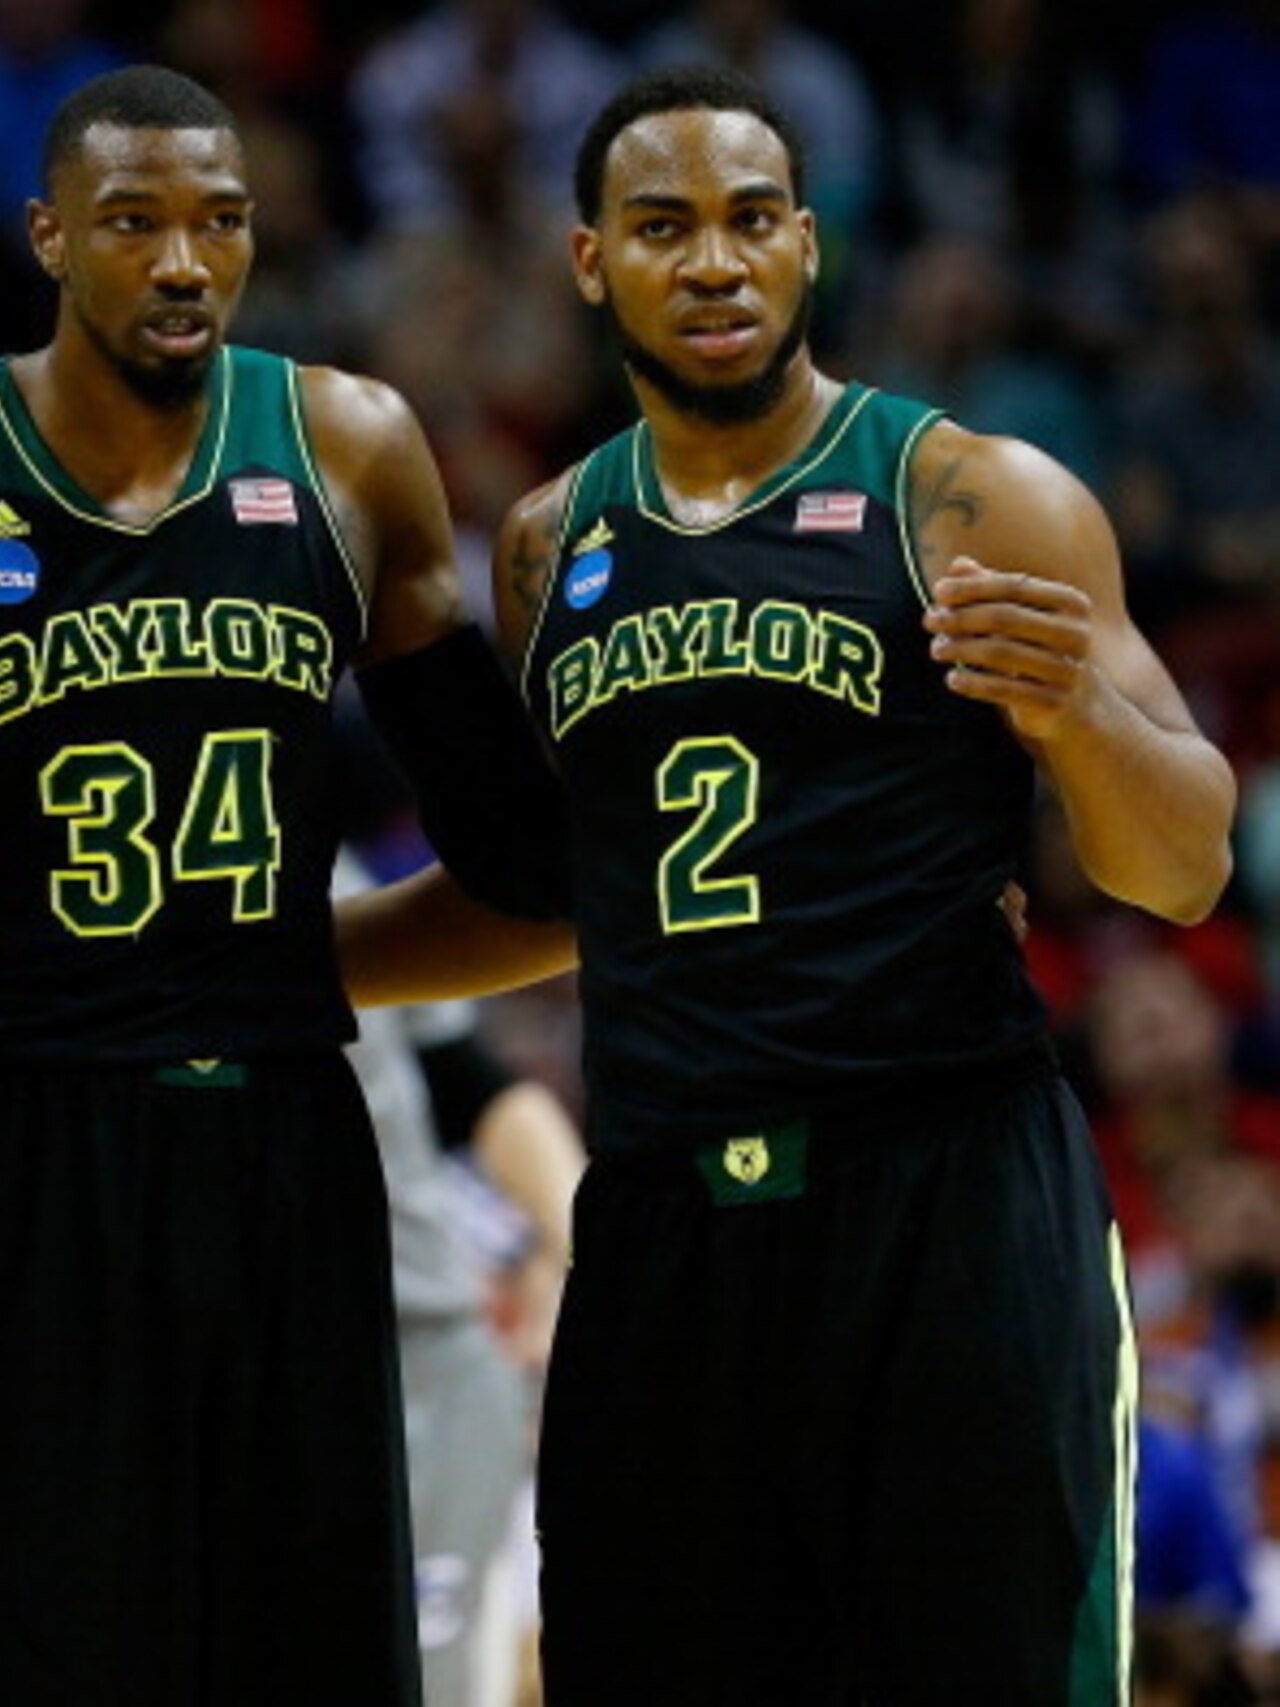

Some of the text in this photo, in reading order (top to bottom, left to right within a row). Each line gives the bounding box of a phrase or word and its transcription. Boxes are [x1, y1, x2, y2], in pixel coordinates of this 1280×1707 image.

[549, 598, 882, 740] BAYLOR
[39, 728, 281, 937] 34
[655, 735, 759, 934] 2
